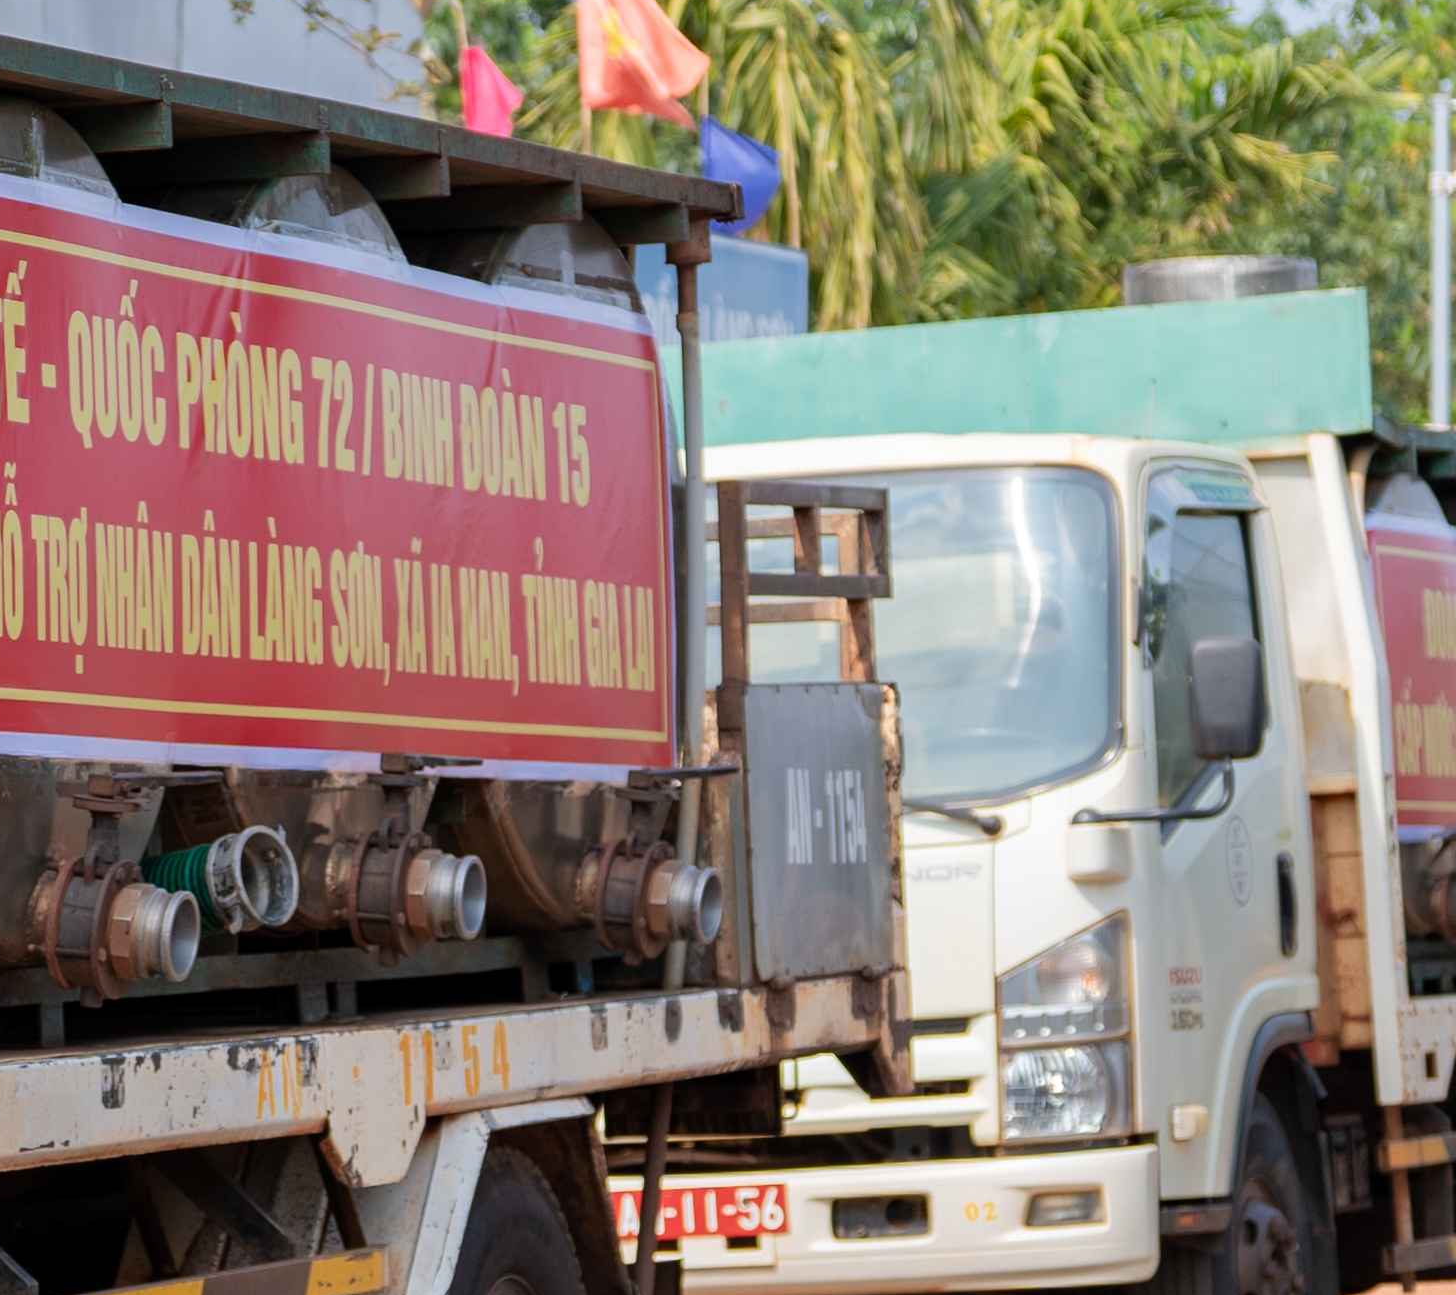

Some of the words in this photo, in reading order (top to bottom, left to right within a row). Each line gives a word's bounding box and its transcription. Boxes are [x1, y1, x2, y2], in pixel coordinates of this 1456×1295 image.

[67, 279, 166, 449] QUỐC
[176, 311, 304, 465] PHÒNG
[312, 356, 355, 472] 72
[381, 368, 454, 488] BINH
[460, 368, 546, 501] ĐOÀN
[552, 401, 590, 507] 15
[31, 507, 88, 674] TRỢ
[95, 500, 174, 653] NHÂN
[181, 510, 241, 658] DÂN
[248, 516, 324, 665] LÀNG
[330, 541, 390, 686] SƠN,
[394, 536, 428, 674] XÃ
[430, 563, 456, 677] IA
[459, 567, 519, 696] NAN,
[522, 536, 581, 685] TỈNH
[584, 579, 623, 688] GIA
[622, 585, 655, 691] LAI
[964, 1202, 998, 1223] 02
